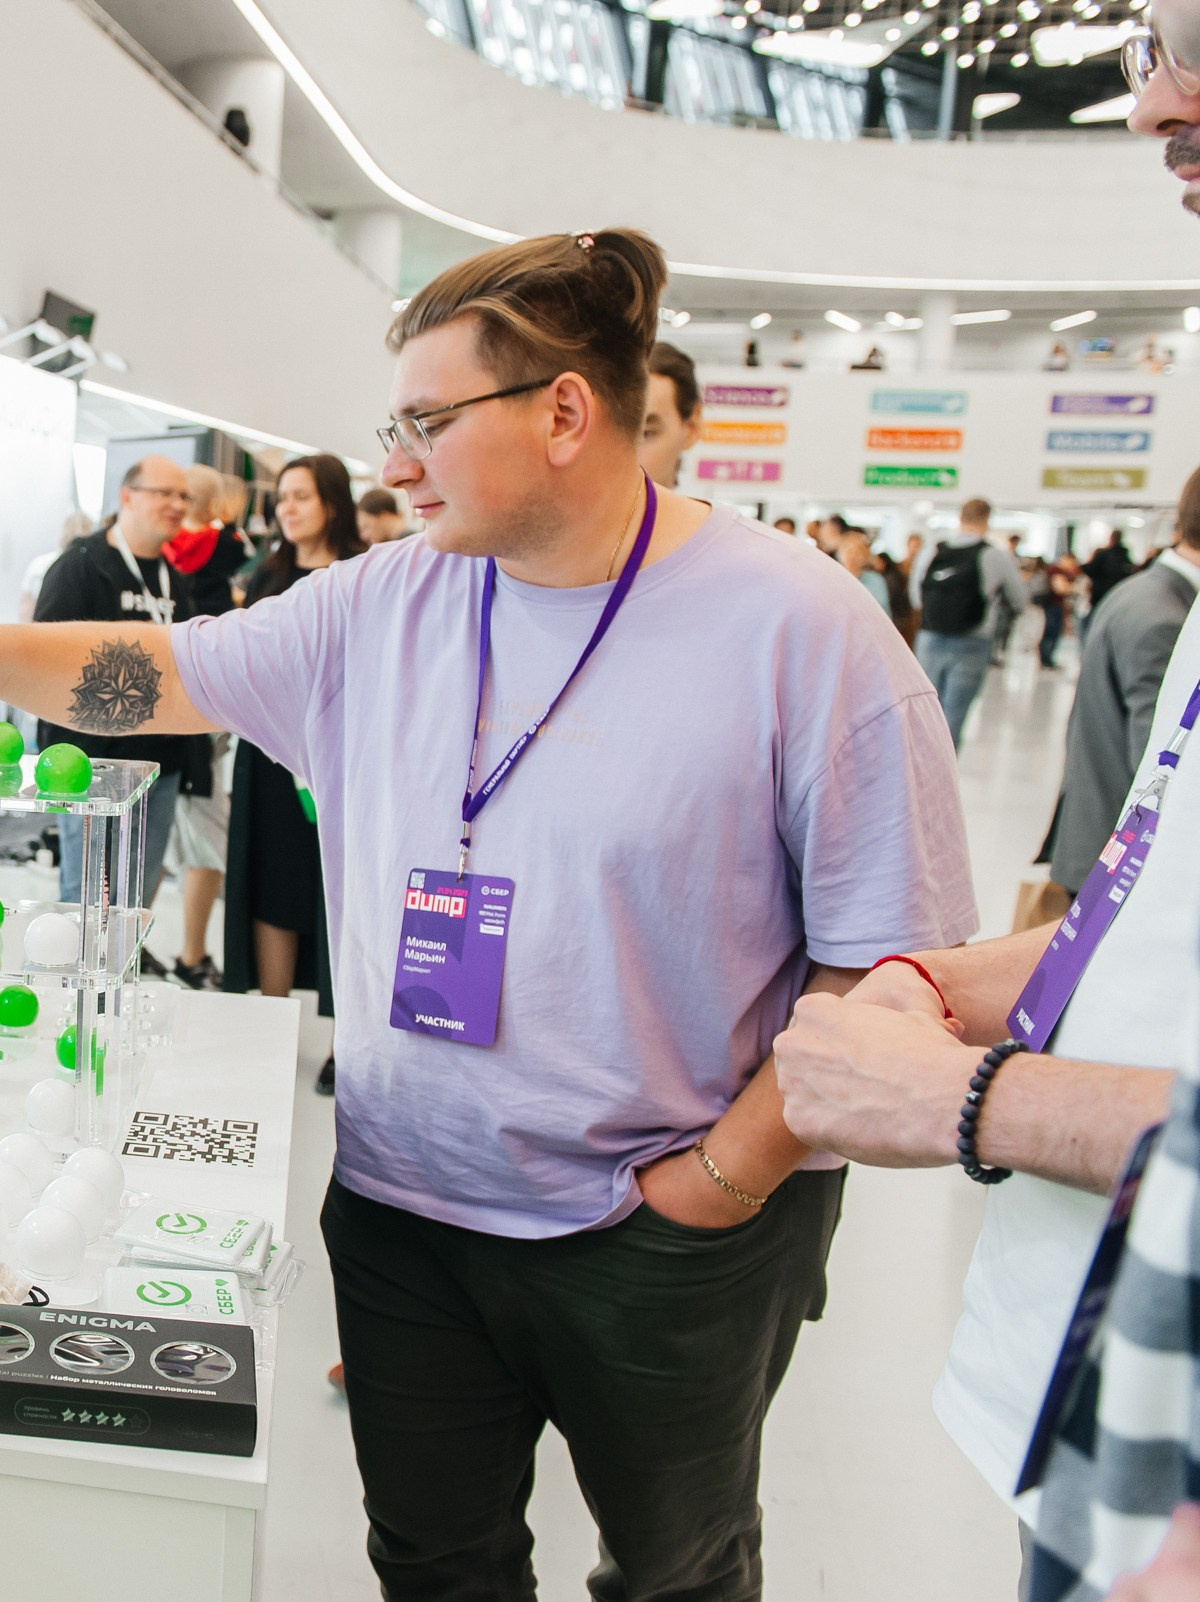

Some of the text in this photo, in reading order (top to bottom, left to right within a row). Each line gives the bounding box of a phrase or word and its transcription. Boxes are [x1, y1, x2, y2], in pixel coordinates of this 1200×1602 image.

[491, 887, 510, 897] СБЕР
[406, 889, 465, 917] dump
[406, 935, 447, 952] Михаил
[404, 948, 446, 965] Марьин
[415, 1013, 465, 1031] УЧАСТНИК
[216, 1288, 235, 1315] СБЕР
[39, 1311, 157, 1333] ENIGMA
[11, 1371, 44, 1379] puzzles
[50, 1374, 217, 1396] Набор металлических головоломок
